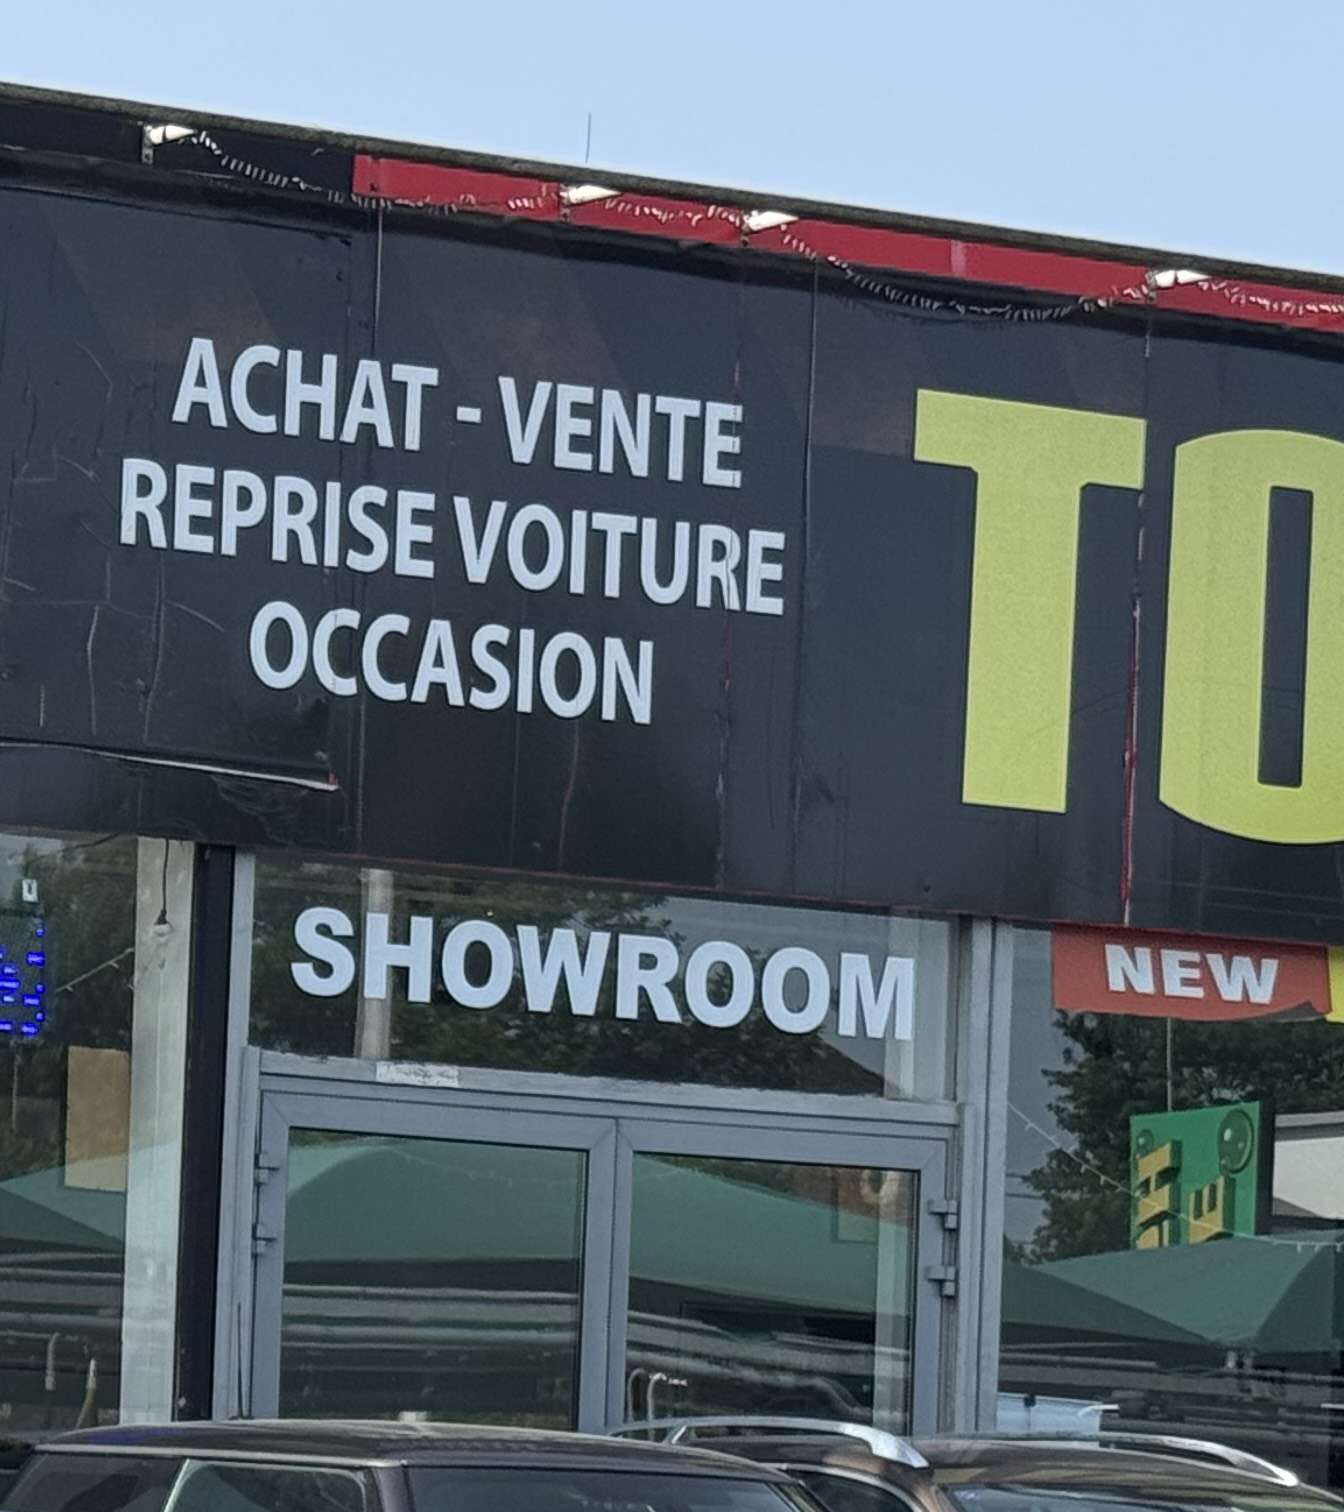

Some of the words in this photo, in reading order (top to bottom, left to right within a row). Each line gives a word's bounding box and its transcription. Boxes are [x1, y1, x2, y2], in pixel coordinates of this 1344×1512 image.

[172, 337, 439, 451] ACHAT
[456, 406, 482, 424] -
[498, 376, 743, 489] VENTE
[119, 457, 436, 579] REPRISE
[453, 496, 786, 616] VOITURE
[249, 601, 654, 726] OCCASION
[291, 907, 916, 1042] SHOWROOM
[1104, 943, 1280, 1005] NEW
